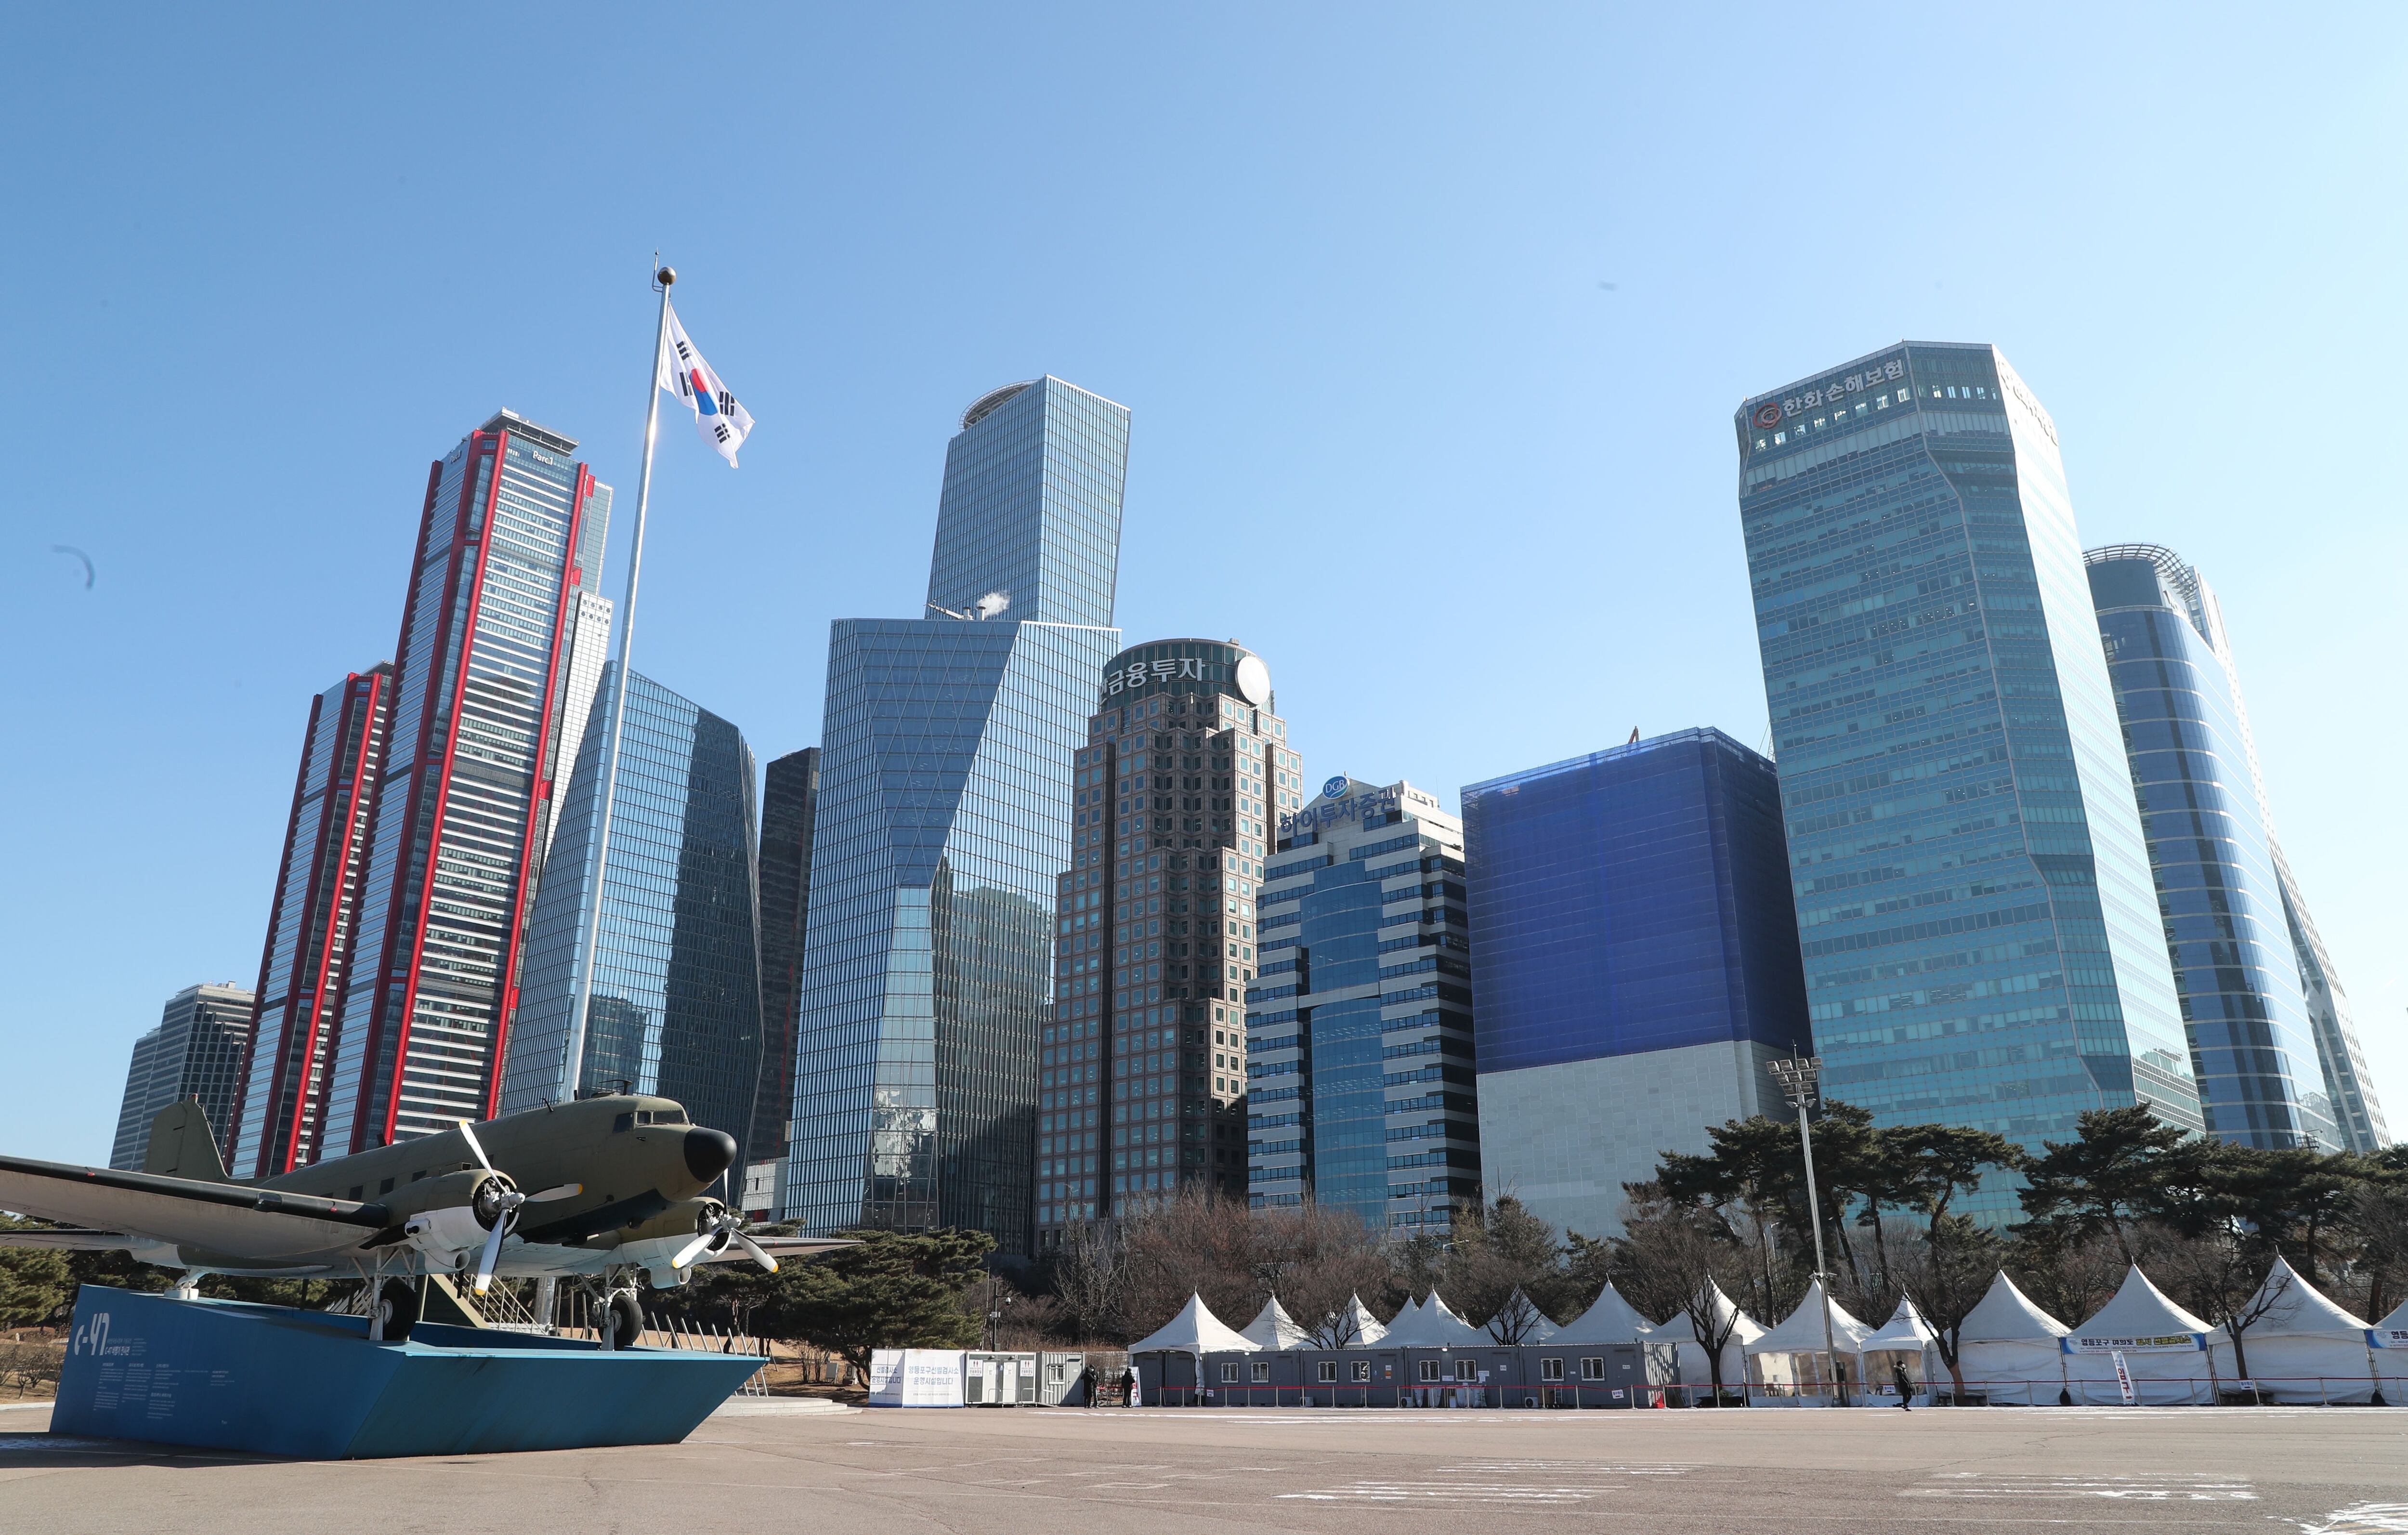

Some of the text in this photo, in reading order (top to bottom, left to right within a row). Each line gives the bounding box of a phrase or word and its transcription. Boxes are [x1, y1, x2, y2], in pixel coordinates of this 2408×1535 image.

[1782, 359, 1904, 418] 한화손해보험
[1325, 779, 1345, 794] DGB
[1281, 787, 1396, 836] 하이투자증권
[2118, 1368, 2130, 1393] 입구
